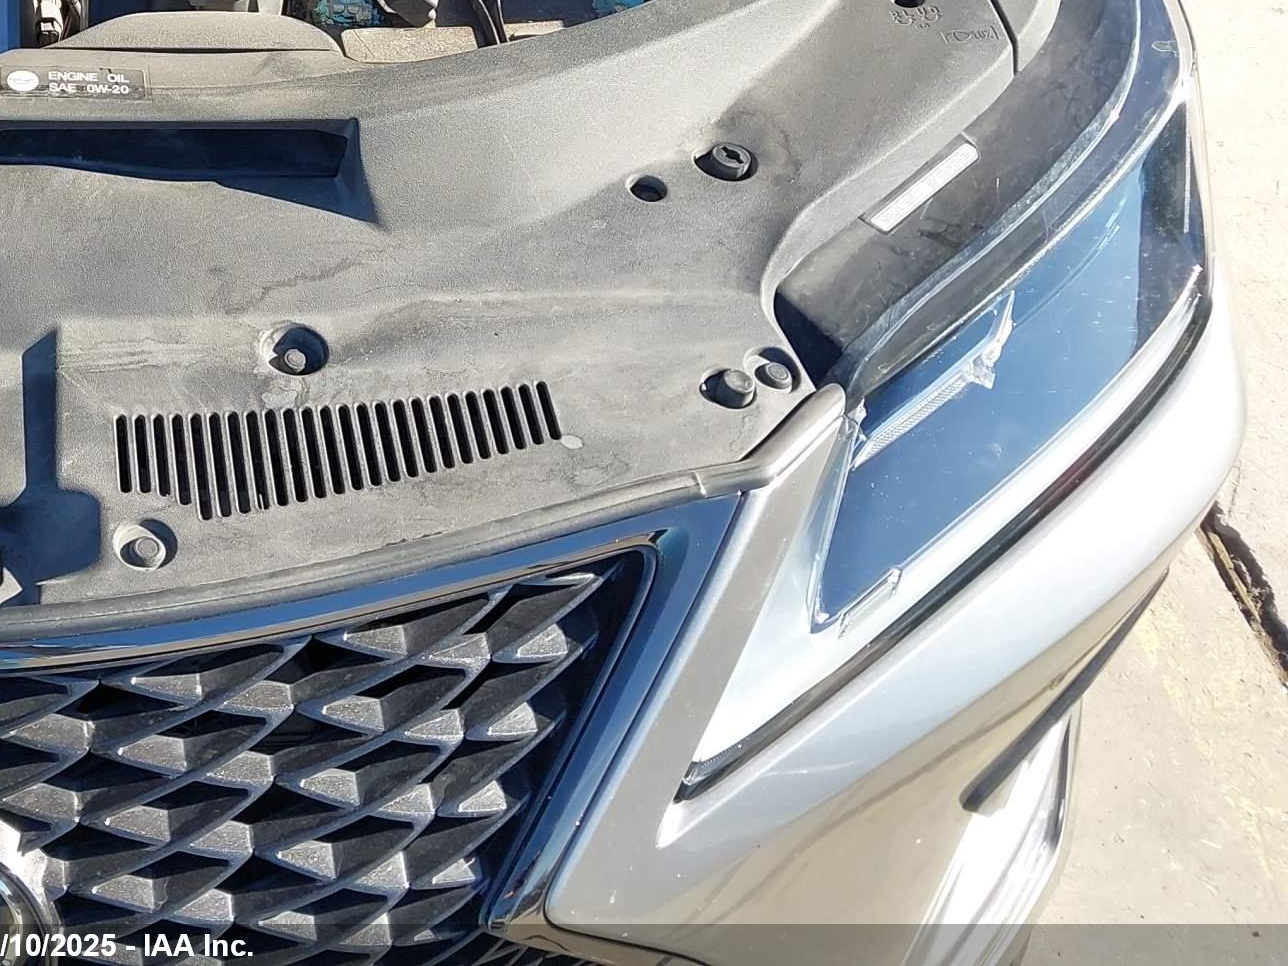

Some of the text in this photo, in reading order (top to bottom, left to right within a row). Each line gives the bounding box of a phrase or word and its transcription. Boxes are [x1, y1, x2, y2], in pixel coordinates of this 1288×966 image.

[48, 71, 130, 83] ENGINE OIL
[48, 83, 130, 94] SAE 0W-20
